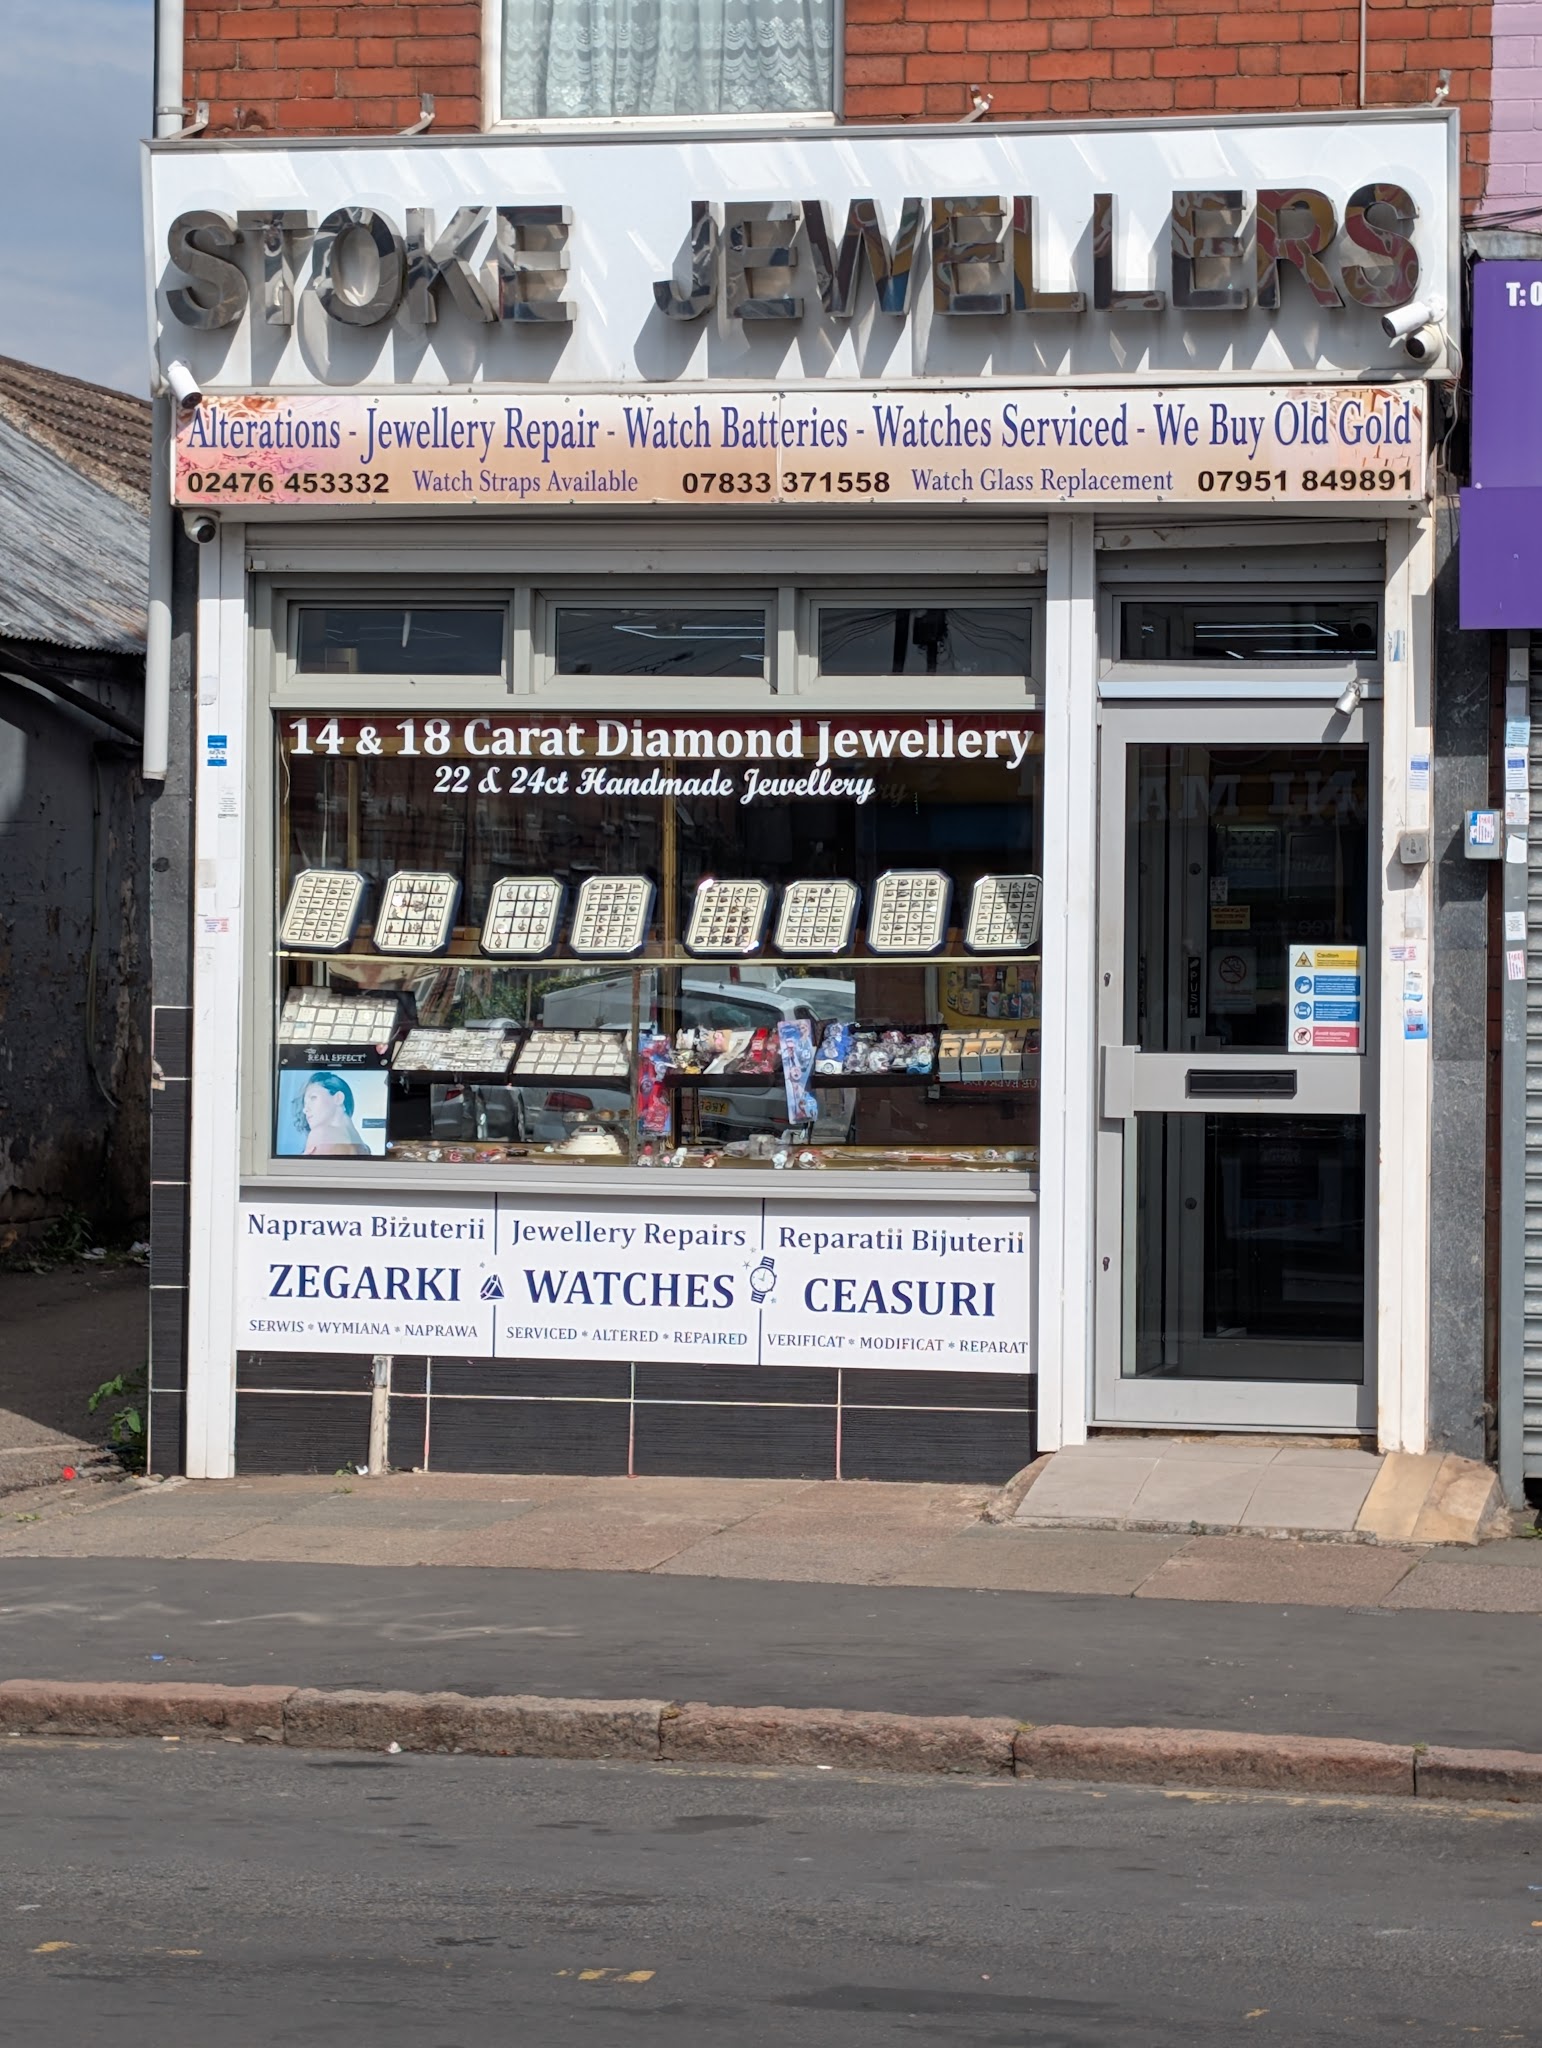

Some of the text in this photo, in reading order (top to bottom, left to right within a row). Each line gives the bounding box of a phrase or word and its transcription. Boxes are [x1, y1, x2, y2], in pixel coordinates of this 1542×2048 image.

[166, 184, 1421, 330] STOKE JEWELLERS
[187, 406, 340, 449] Alterations
[360, 406, 495, 465] Jewellery
[504, 406, 599, 463] Repair
[623, 405, 711, 449] Watch
[721, 405, 848, 449] Batteries
[872, 403, 991, 447] Watches
[1002, 402, 1128, 447] Serviced
[1153, 403, 1199, 446] We
[1209, 402, 1265, 460] Buy
[1274, 400, 1329, 445] Old
[1338, 399, 1411, 445] Gold
[187, 472, 390, 493] 02476 453332
[412, 469, 639, 499] Watch Straps Available
[682, 471, 890, 493] 07833 371558
[911, 467, 1174, 497] Watch Glass Replacement
[1197, 469, 1412, 491] 07951 849891
[289, 717, 1035, 769] 14 & 18 Carat Diamond Jewellery
[433, 765, 470, 793] 22
[477, 766, 502, 794] &
[509, 766, 569, 795] 24ct
[575, 766, 734, 796] Handmade
[740, 767, 875, 805] Jewellery
[248, 1213, 485, 1241] Naprawa Biżuterii
[512, 1219, 746, 1250] Jewellery Repairs
[778, 1226, 1025, 1257] Reparatii Bijuterii
[268, 1263, 462, 1302] ZEGARKI
[523, 1268, 735, 1309] WATCHES
[804, 1277, 996, 1317] CEASURI
[249, 1319, 478, 1338] SERWIS WYMIANA NAPRAWA
[506, 1326, 747, 1346] SERVICED ALTERED REPAIRED
[767, 1333, 1028, 1354] VERIFICAT MODIFICAT REPARAT
